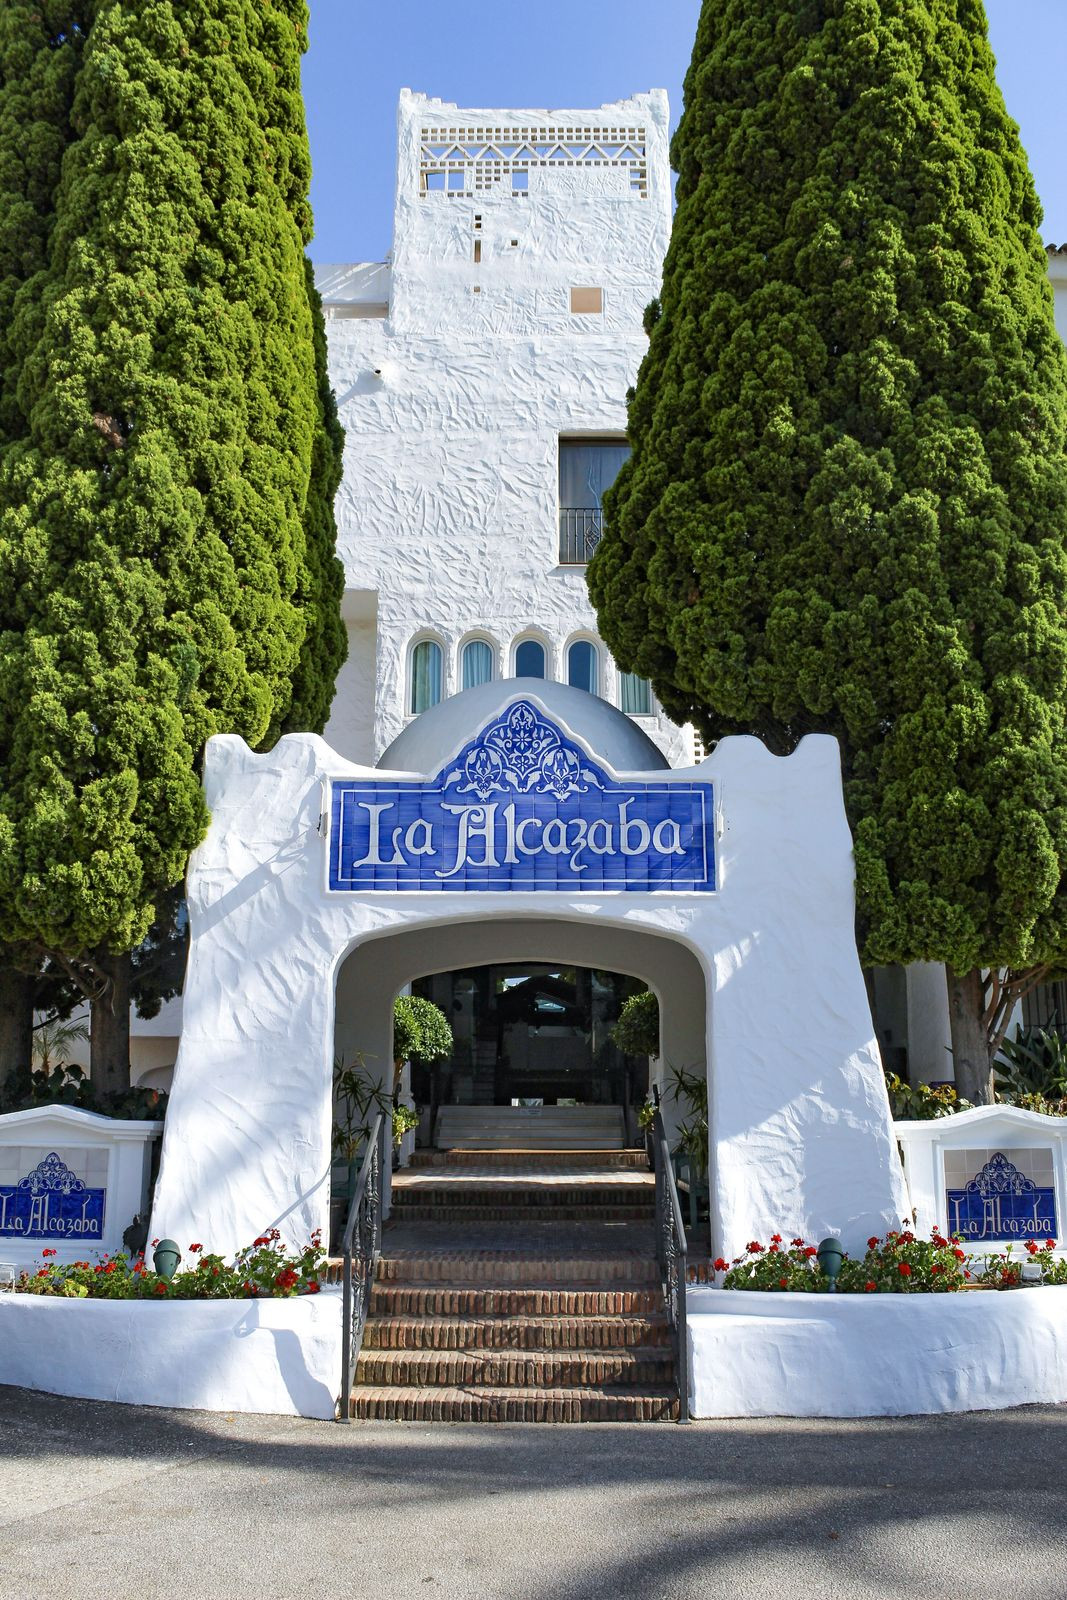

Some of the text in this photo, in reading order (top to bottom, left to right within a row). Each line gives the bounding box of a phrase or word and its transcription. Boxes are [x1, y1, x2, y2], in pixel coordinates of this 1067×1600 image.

[352, 797, 686, 877] La Alcazaba
[0, 1192, 99, 1237] La Alcazaba
[950, 1194, 1052, 1237] La Alcazaba
